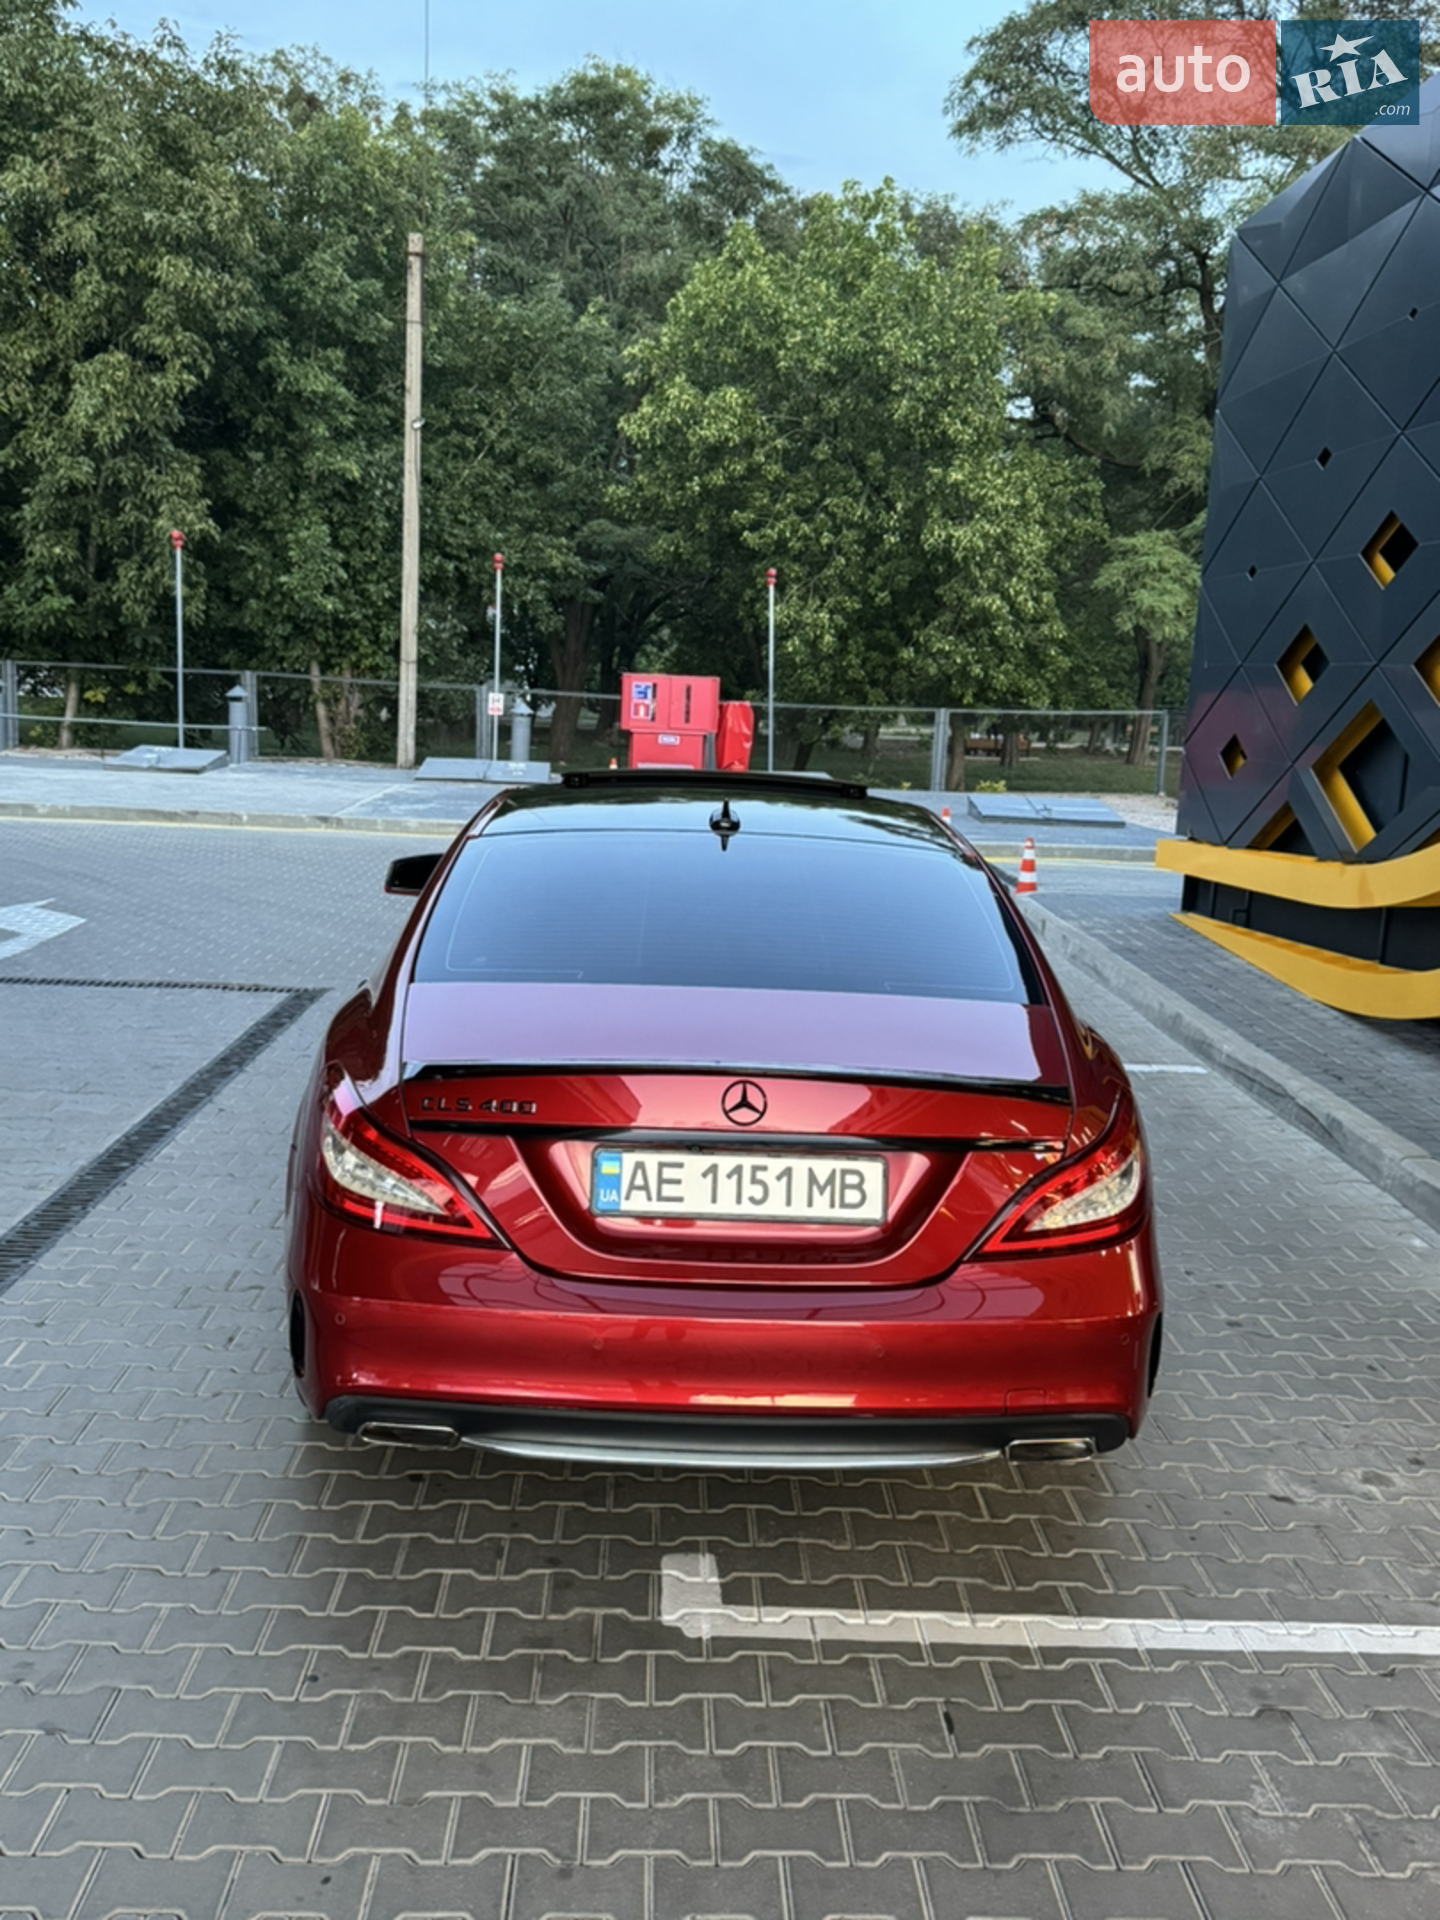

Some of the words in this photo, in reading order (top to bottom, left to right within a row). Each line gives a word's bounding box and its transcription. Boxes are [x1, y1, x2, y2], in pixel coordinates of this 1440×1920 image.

[422, 1097, 472, 1112] CLS
[479, 1099, 537, 1114] 400
[624, 1161, 685, 1203] AE
[701, 1163, 793, 1207] 1151
[807, 1167, 867, 1210] MB
[600, 1188, 619, 1203] UA
